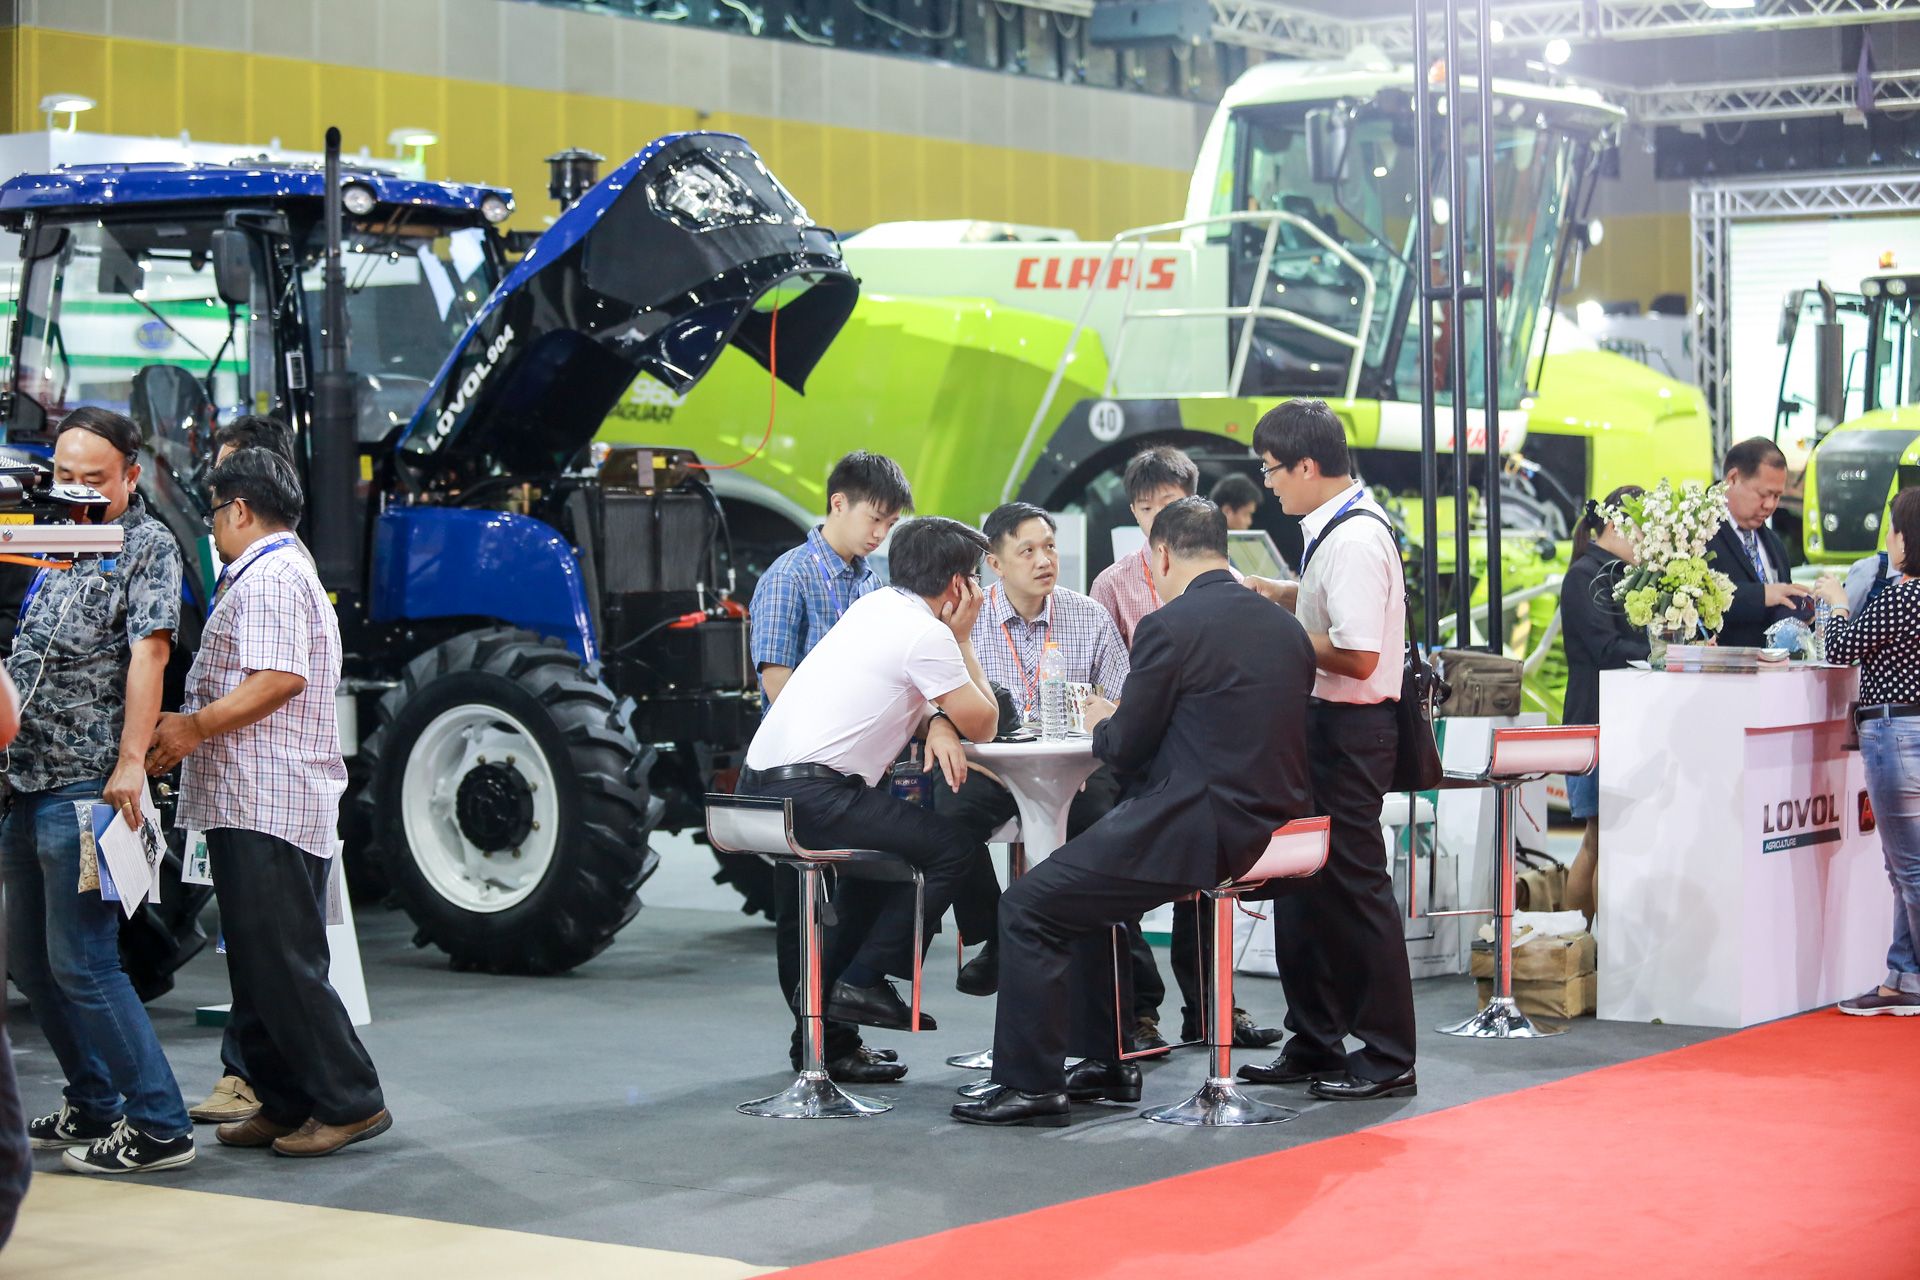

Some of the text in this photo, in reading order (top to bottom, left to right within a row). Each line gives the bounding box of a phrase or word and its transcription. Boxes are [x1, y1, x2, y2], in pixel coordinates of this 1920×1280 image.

[1014, 257, 1177, 291] CLAAS
[427, 324, 514, 451] LOVOL 904
[1095, 408, 1117, 432] 40
[1763, 793, 1840, 833] LOVOL
[1764, 837, 1797, 851] AGRICULTURE
